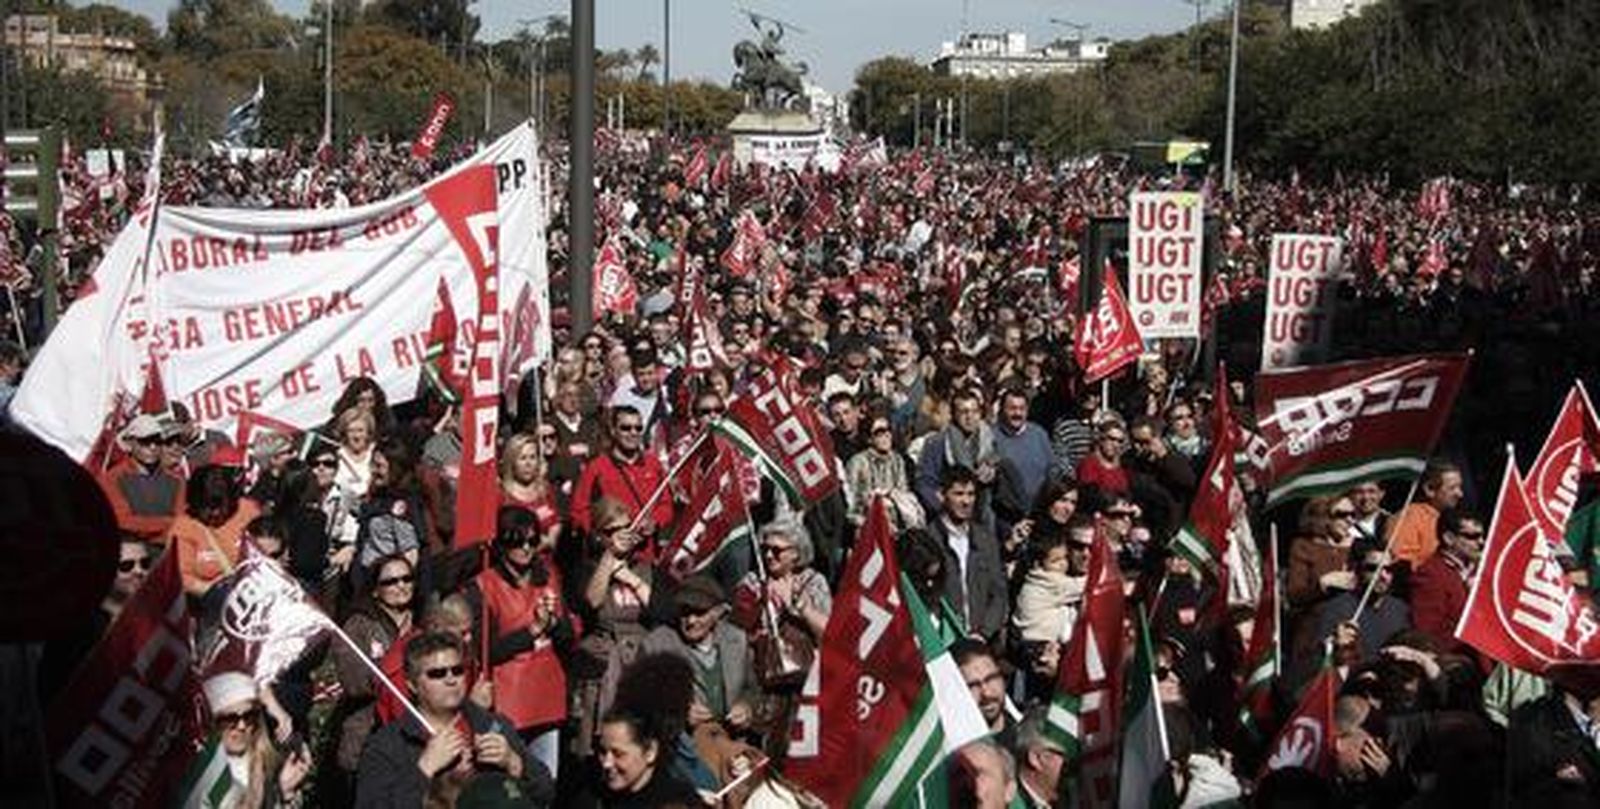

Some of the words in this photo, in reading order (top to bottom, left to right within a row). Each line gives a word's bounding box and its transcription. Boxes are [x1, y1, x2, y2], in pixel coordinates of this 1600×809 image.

[1136, 200, 1197, 232] UGT
[291, 226, 345, 254] DEL
[1136, 236, 1195, 268] UGT
[1277, 241, 1334, 272] UGT
[1136, 273, 1193, 304] UGT
[1274, 277, 1328, 307] UGT
[224, 290, 363, 342] GENERAL
[190, 378, 263, 425] JOSE
[281, 362, 320, 399] DE
[335, 347, 377, 384] LA
